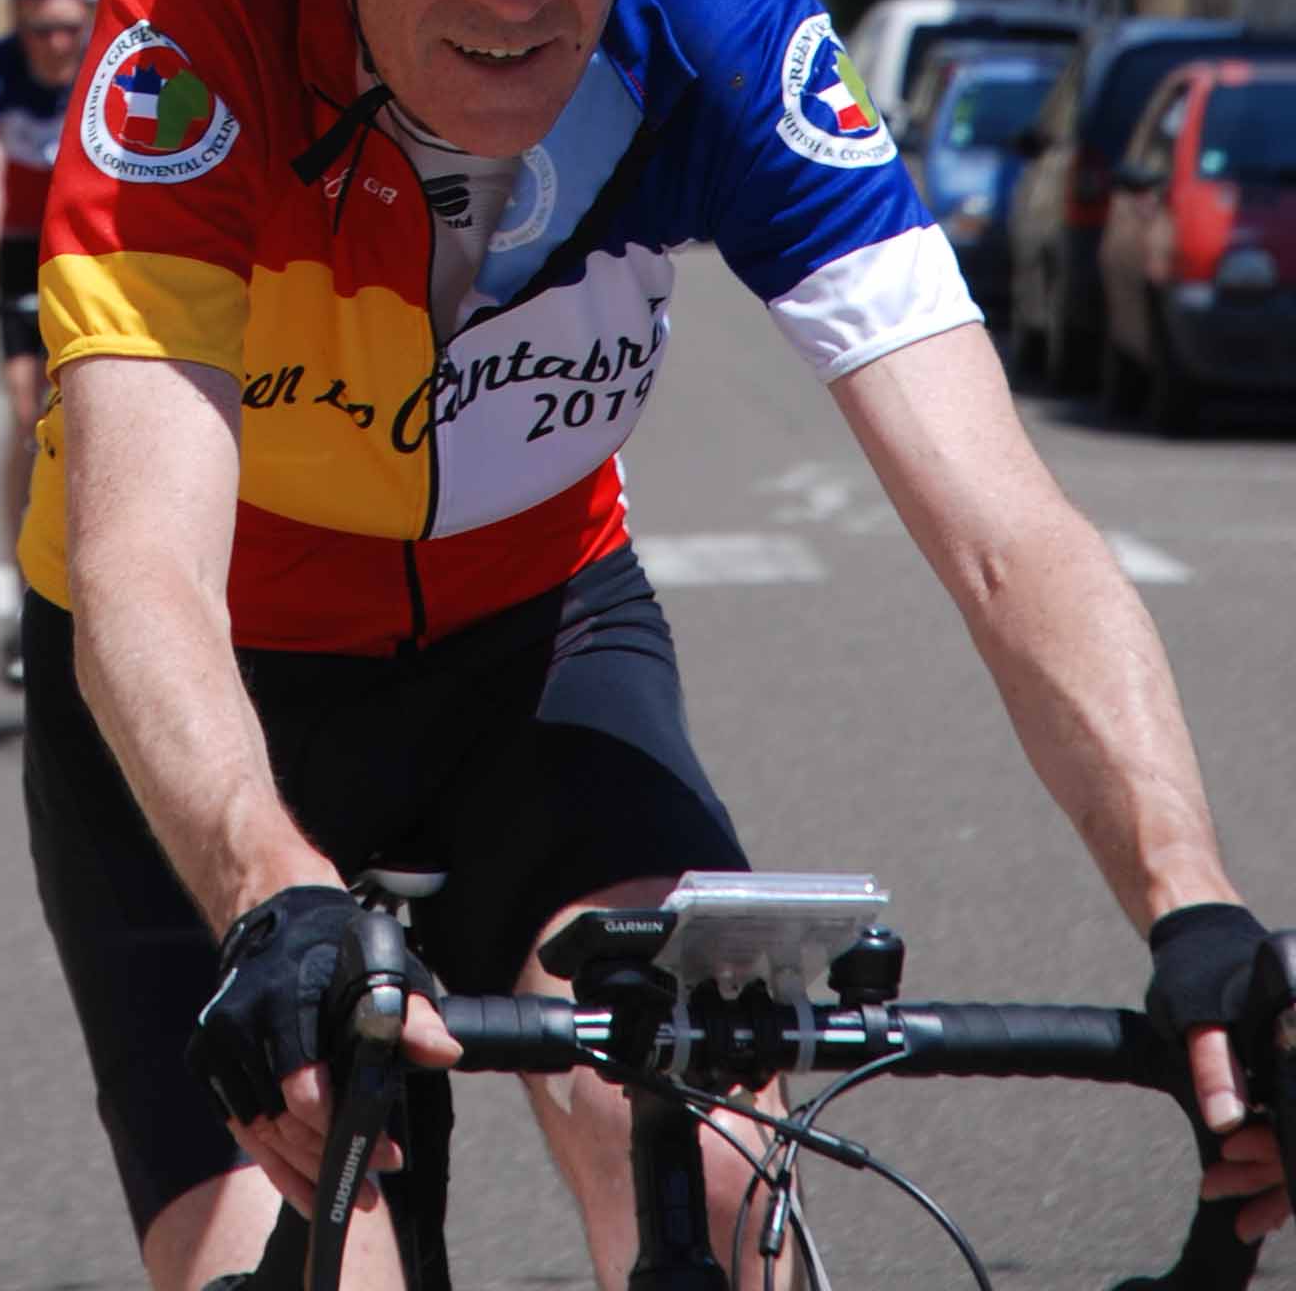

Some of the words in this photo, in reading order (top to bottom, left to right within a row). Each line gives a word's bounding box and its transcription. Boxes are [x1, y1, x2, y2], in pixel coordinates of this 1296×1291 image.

[103, 152, 202, 177] CONTINENTAL
[201, 113, 235, 162] CYCLIN
[241, 365, 304, 409] en
[526, 369, 654, 442] 2019
[605, 921, 664, 933] GARMIN
[330, 1135, 366, 1224] SHIMANO
